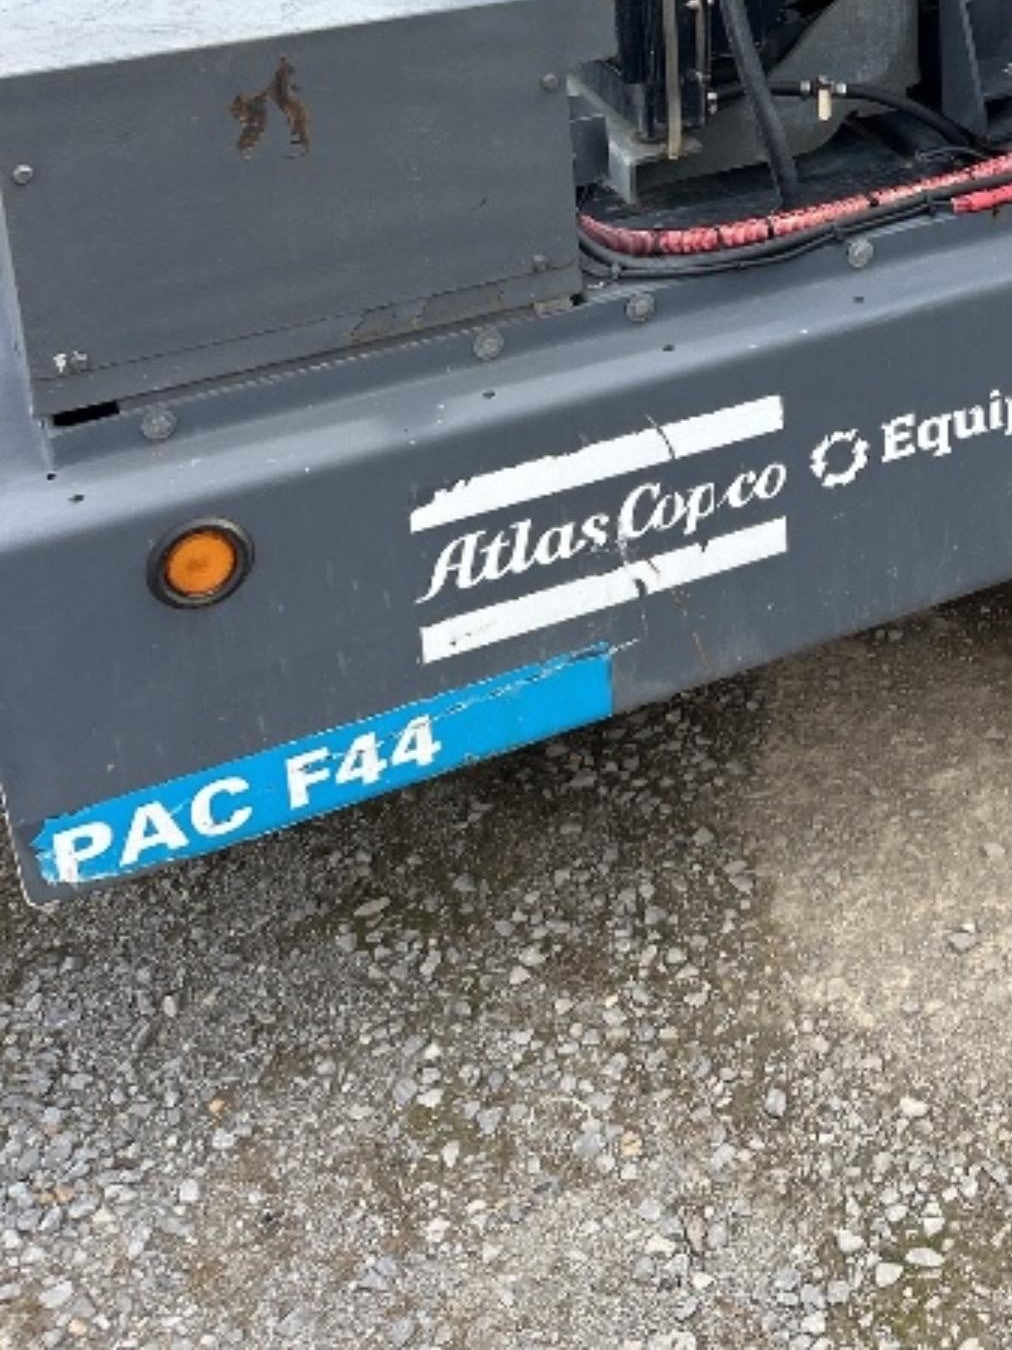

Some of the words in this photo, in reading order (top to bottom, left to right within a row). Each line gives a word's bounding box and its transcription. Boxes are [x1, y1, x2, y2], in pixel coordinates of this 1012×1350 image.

[415, 512, 610, 604] Atlas
[617, 461, 788, 540] Copco
[52, 776, 254, 888] PAC
[285, 713, 442, 811] F44
